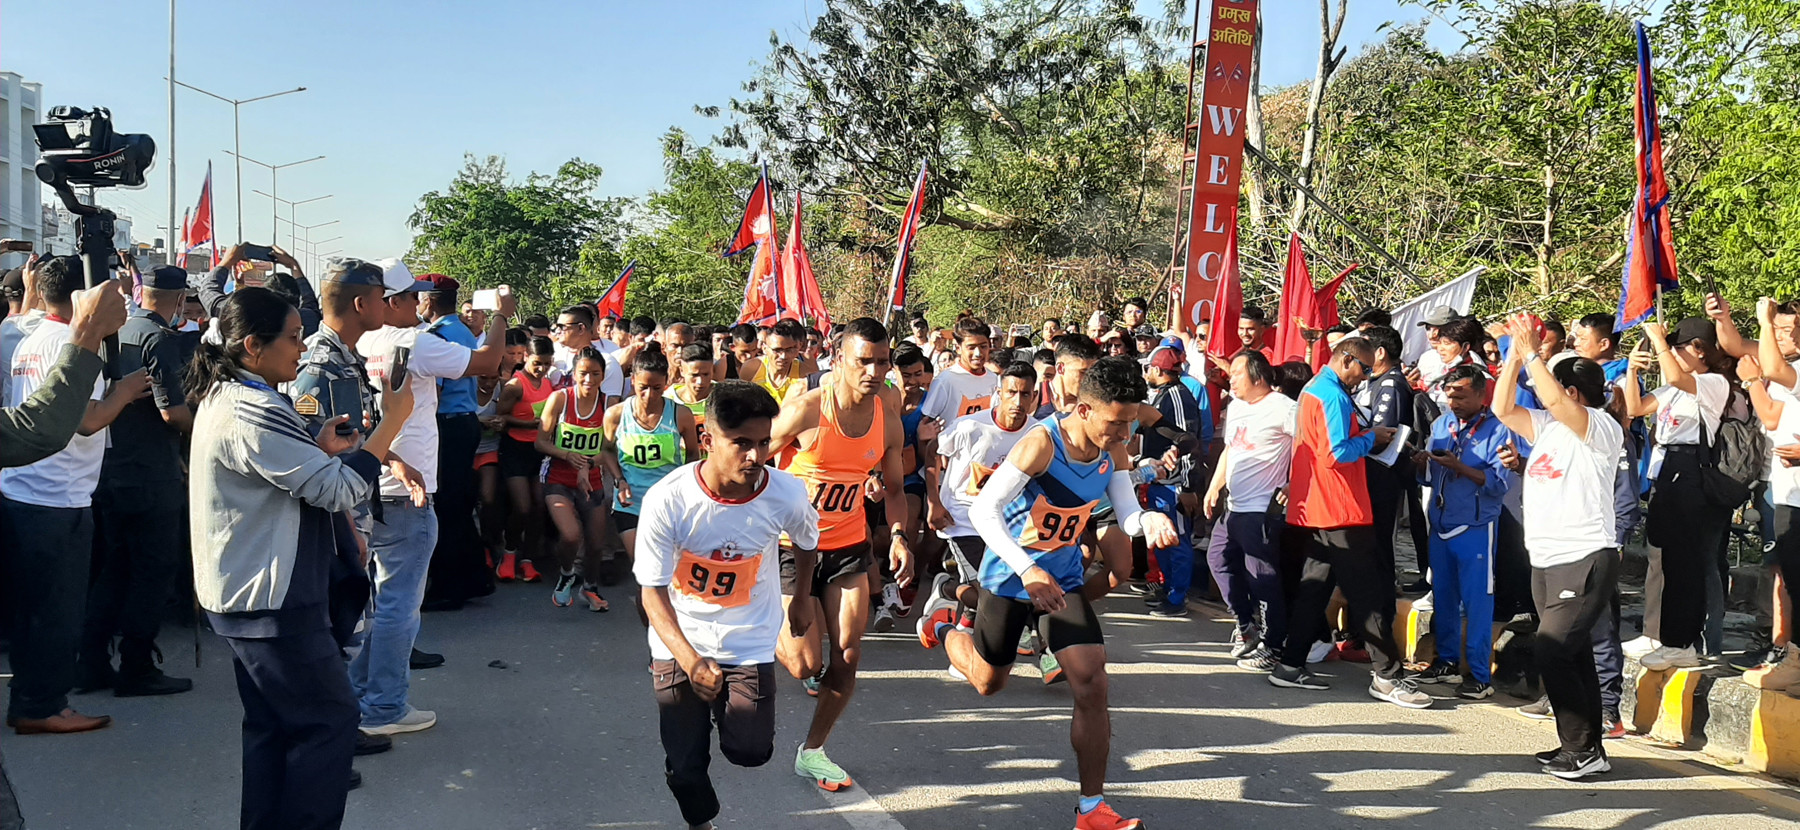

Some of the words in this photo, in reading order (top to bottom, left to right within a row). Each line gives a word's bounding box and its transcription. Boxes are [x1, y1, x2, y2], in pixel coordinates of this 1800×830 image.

[1218, 6, 1251, 24] प्रमुख
[1212, 27, 1253, 46] अतिथि
[93, 153, 126, 170] RONIN
[561, 431, 600, 450] 200
[633, 444, 662, 465] 03
[811, 483, 860, 512] 100
[1038, 512, 1080, 542] 98
[687, 563, 737, 597] 99
